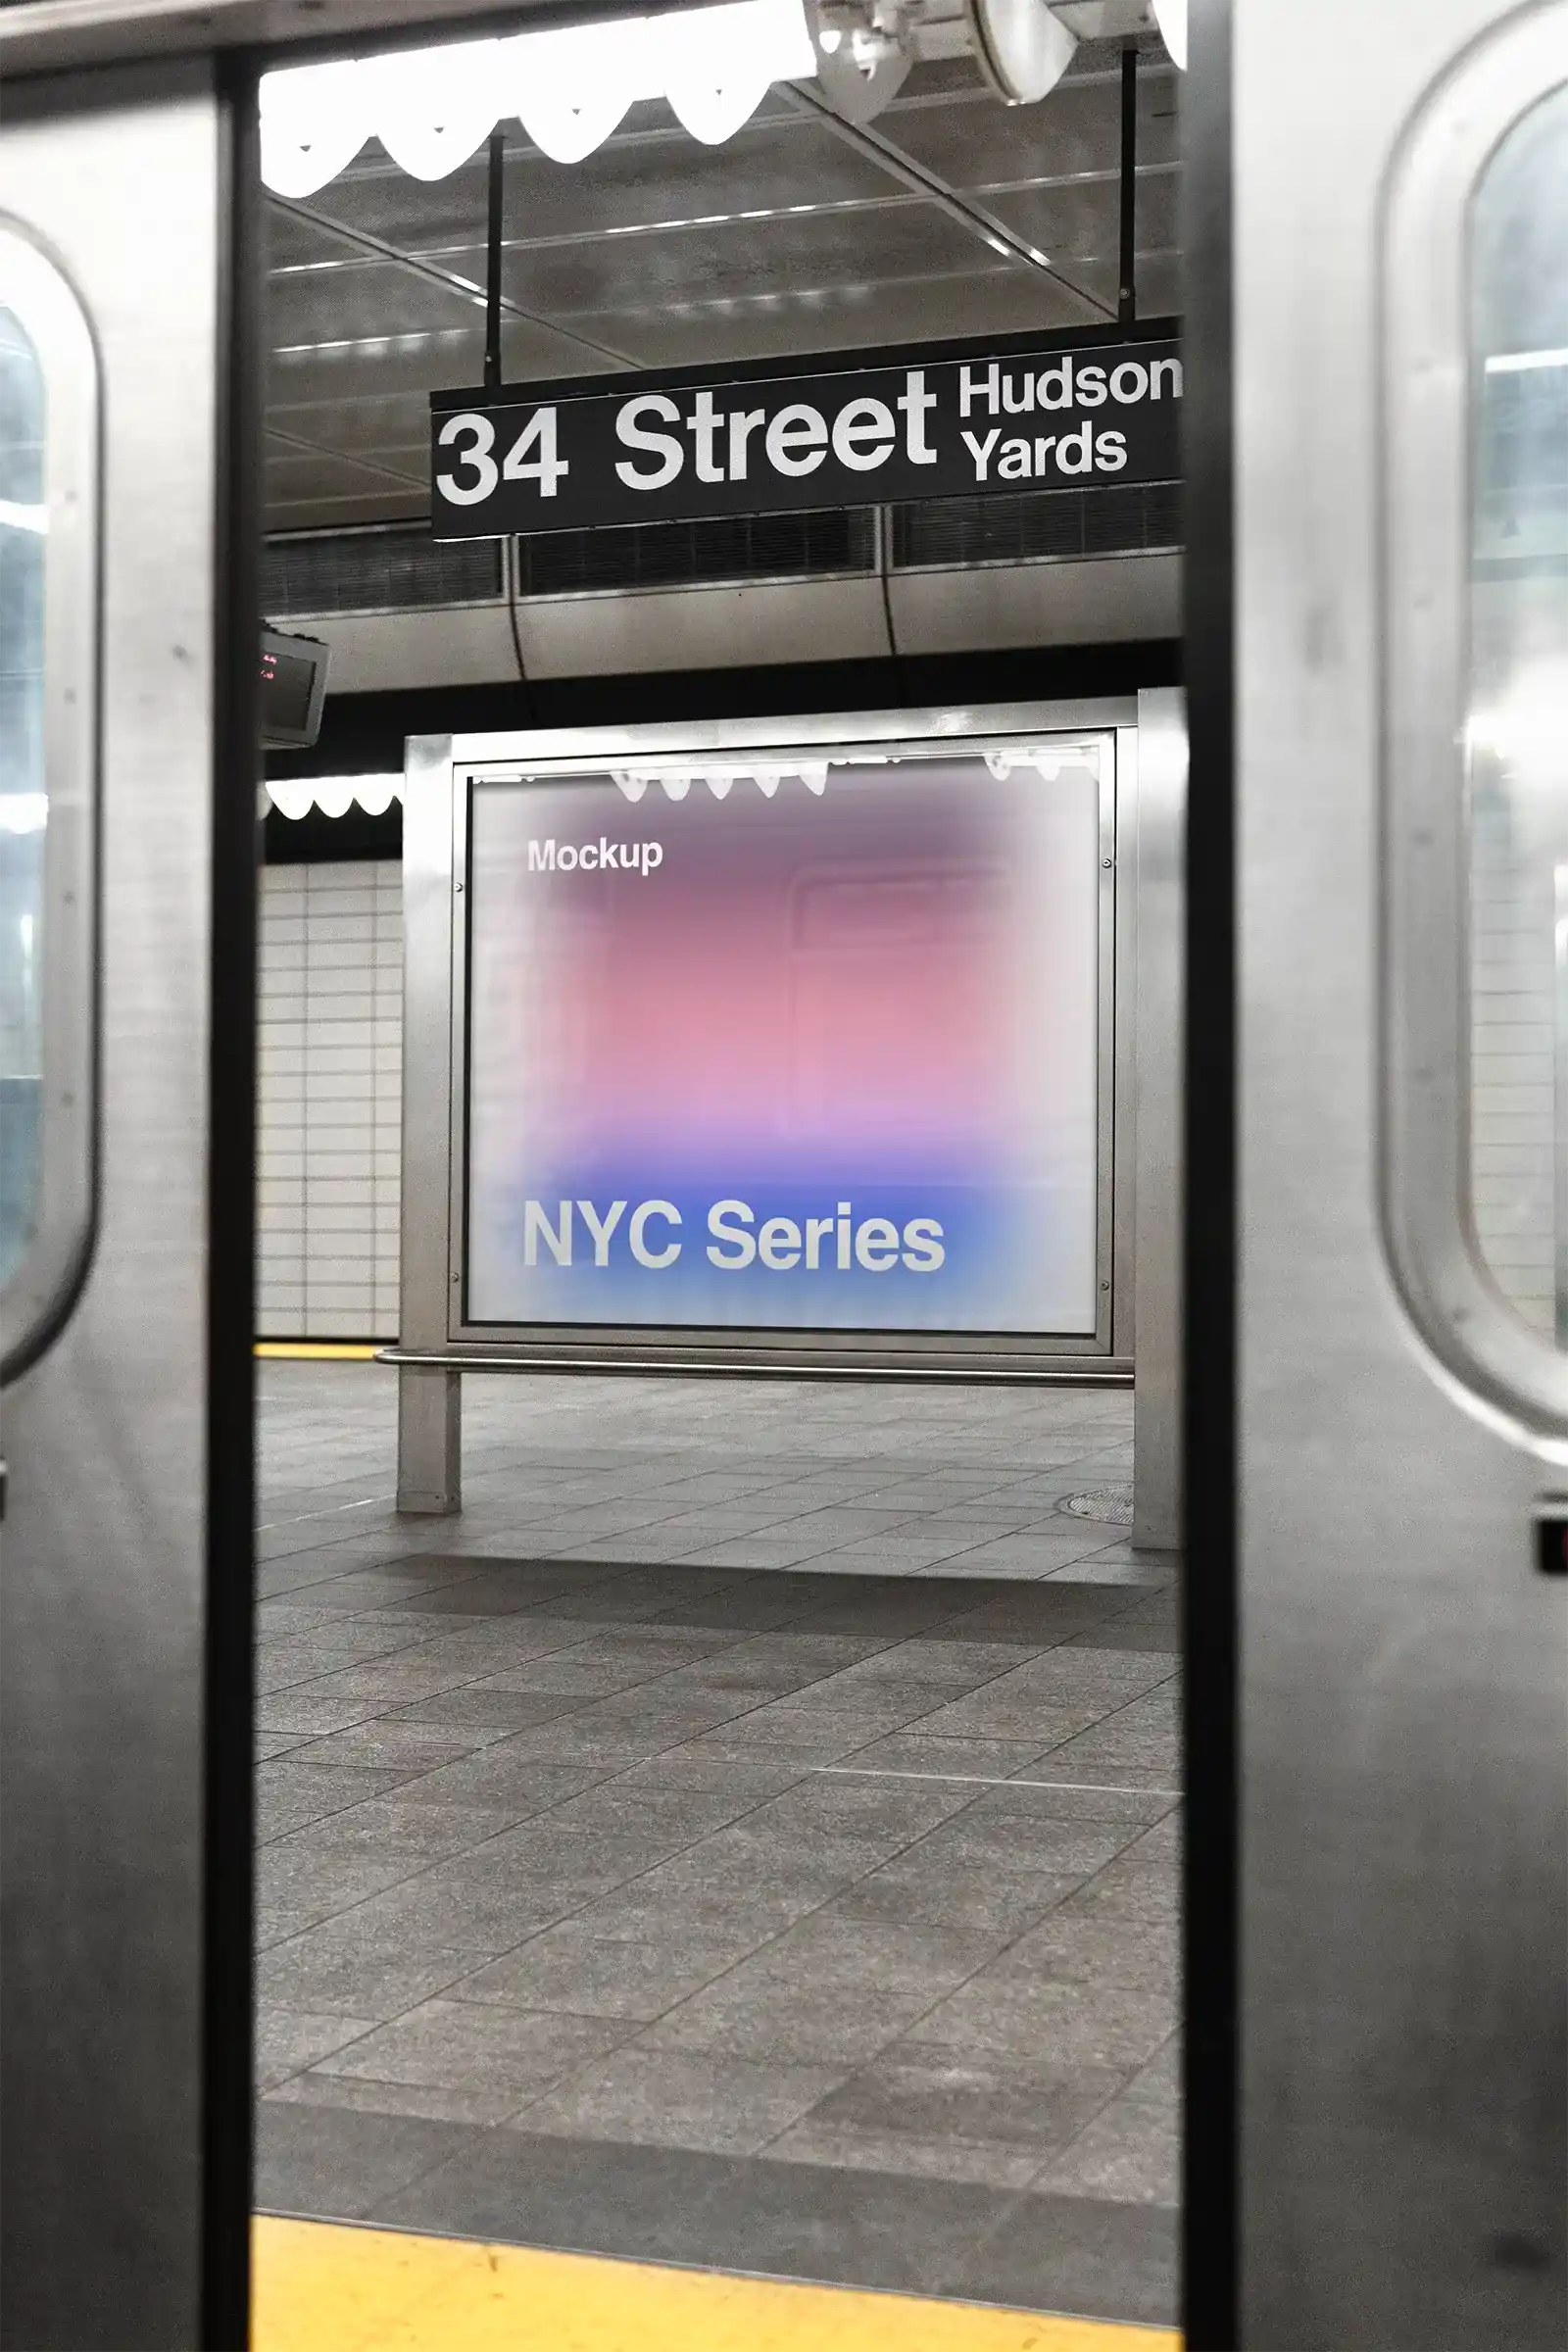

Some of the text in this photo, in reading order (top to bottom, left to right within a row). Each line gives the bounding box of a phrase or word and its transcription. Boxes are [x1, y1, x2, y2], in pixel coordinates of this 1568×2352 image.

[958, 355, 1184, 417] Hudson
[435, 370, 938, 507] 34 Street
[959, 420, 1128, 482] Yards
[527, 837, 664, 876] Mockup
[522, 1199, 946, 1272] NYC Series
